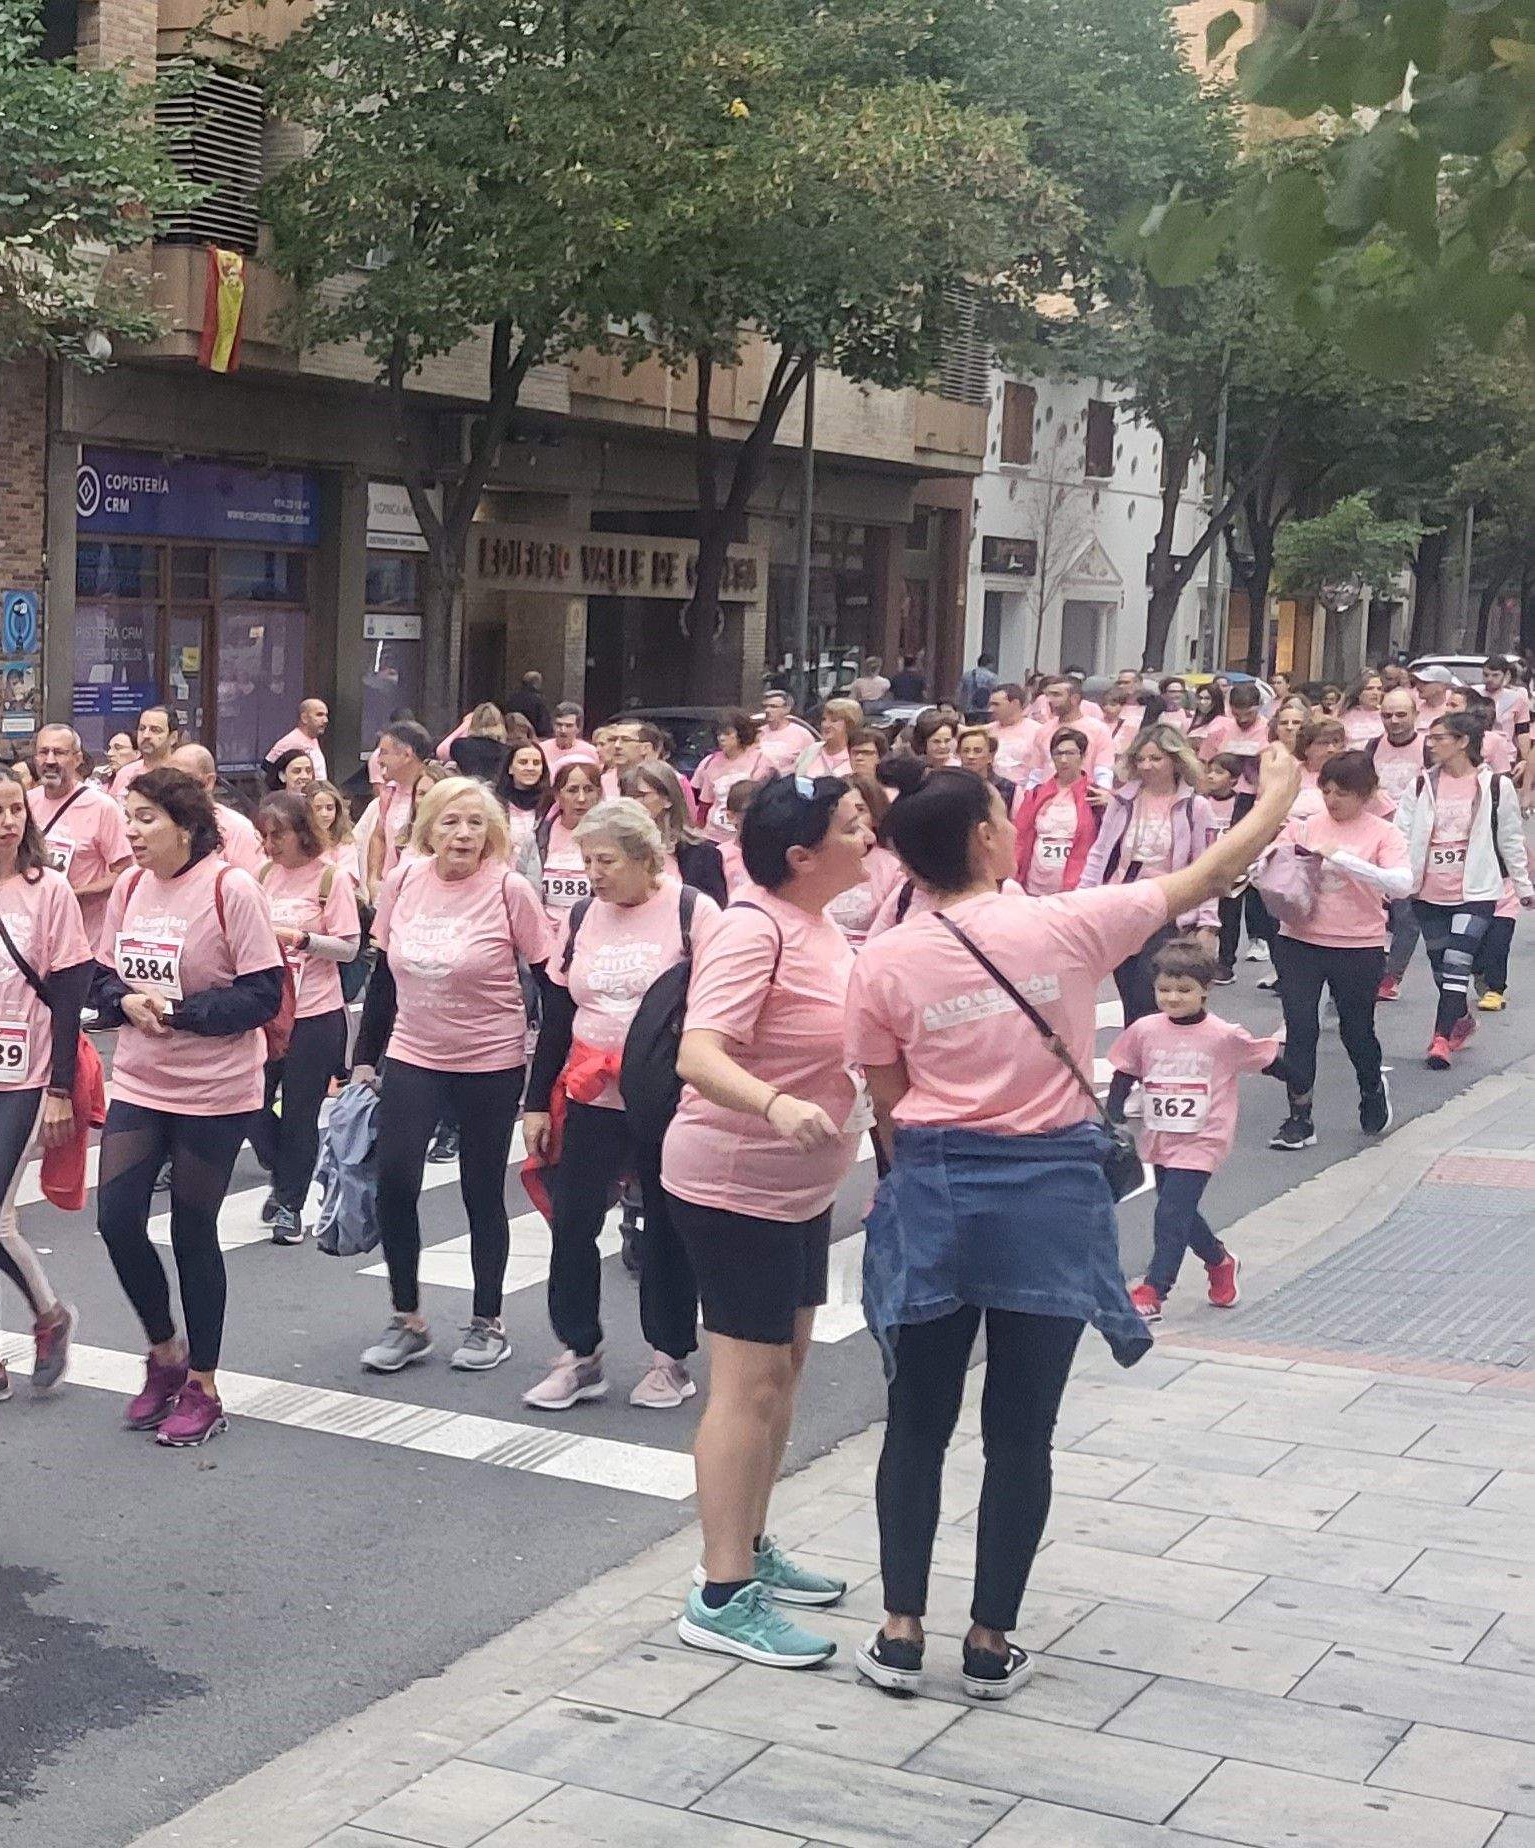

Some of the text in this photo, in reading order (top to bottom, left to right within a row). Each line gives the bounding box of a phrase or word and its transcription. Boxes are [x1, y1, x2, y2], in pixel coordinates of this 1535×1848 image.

[104, 474, 169, 494] COPISTERÍA
[104, 497, 130, 513] CRM
[650, 551, 679, 589] DE
[1434, 849, 1467, 865] 592
[543, 879, 588, 897] 1988
[122, 956, 175, 984] 2884
